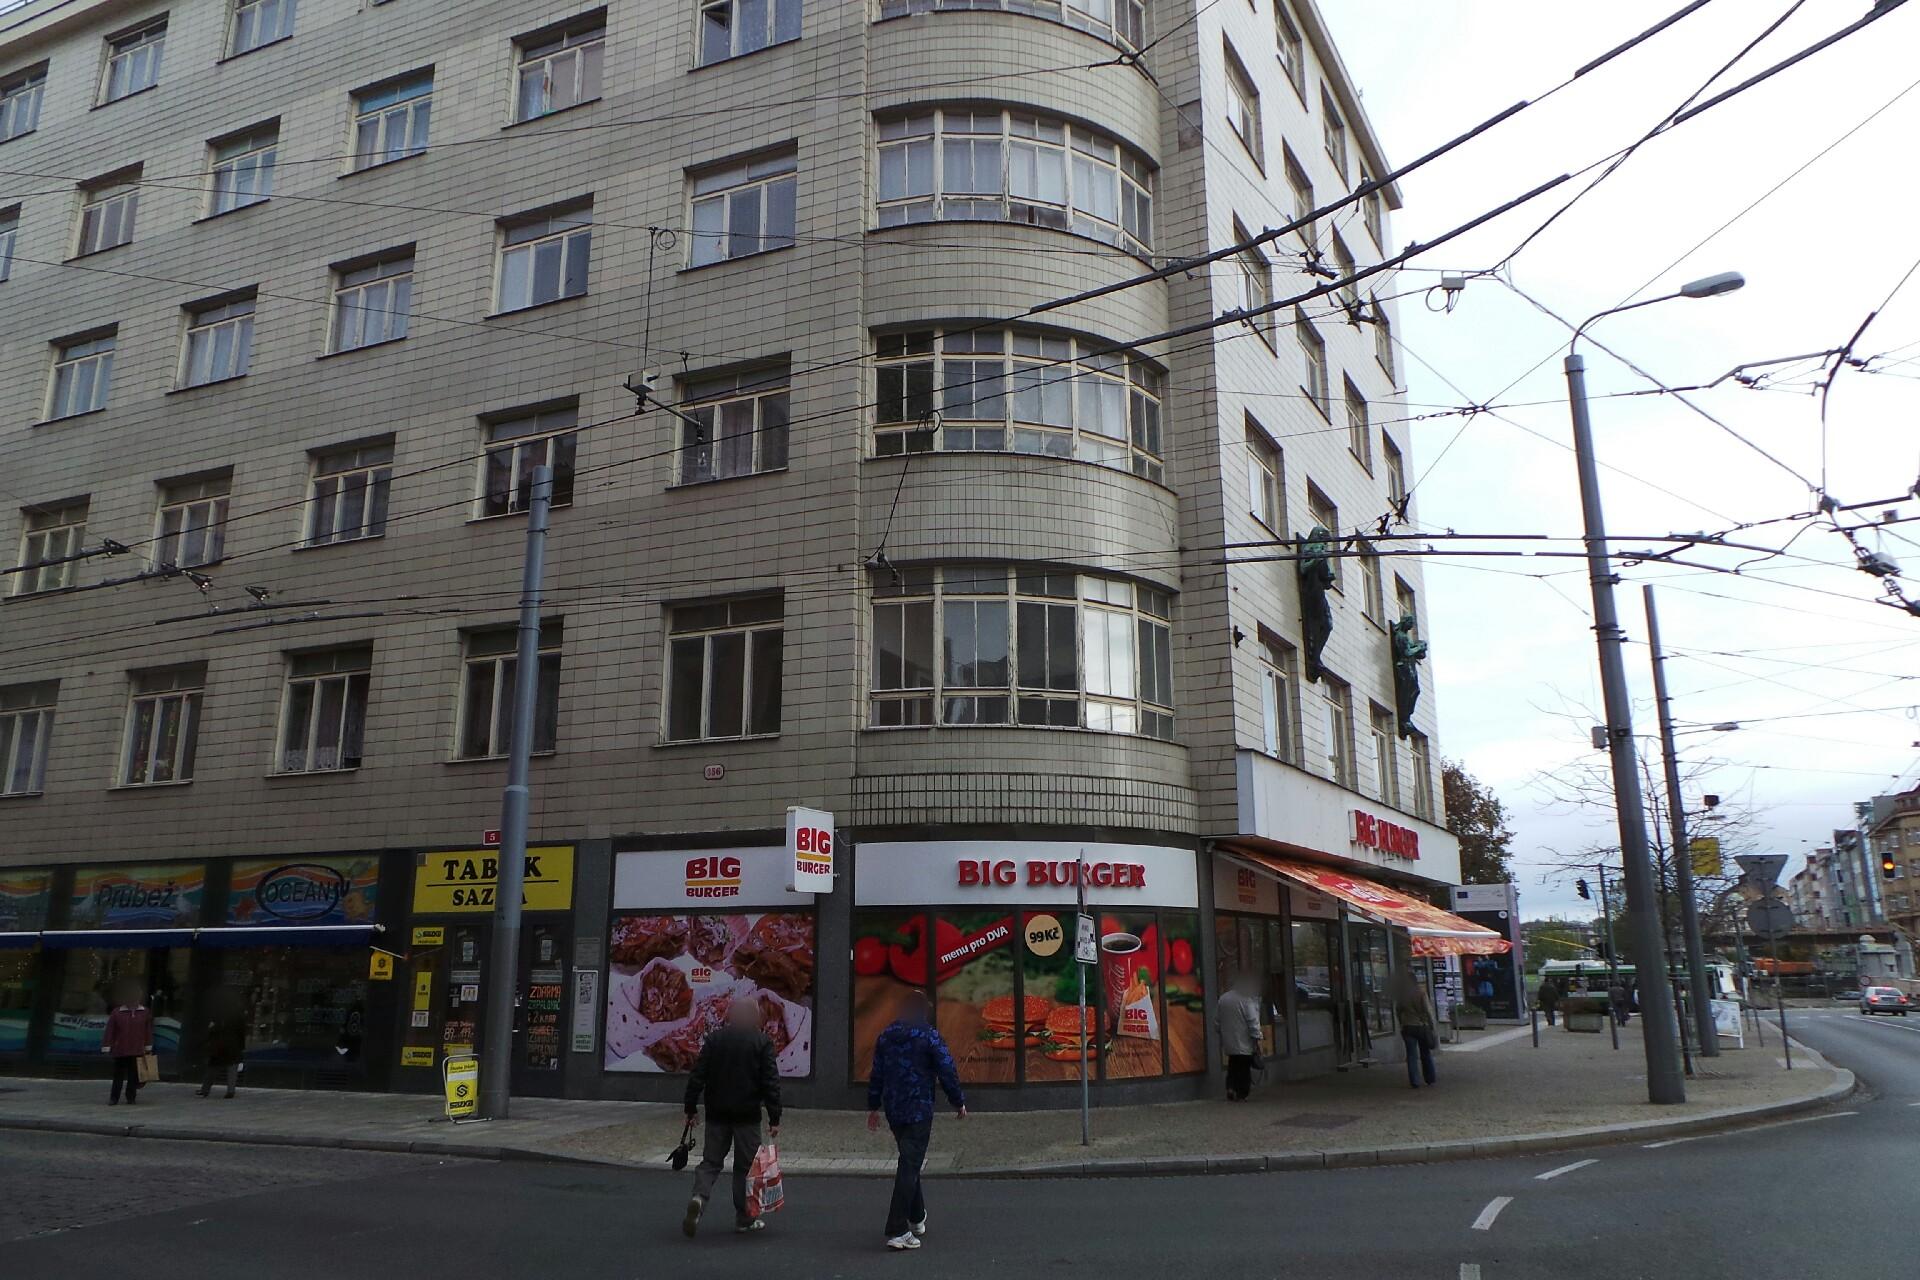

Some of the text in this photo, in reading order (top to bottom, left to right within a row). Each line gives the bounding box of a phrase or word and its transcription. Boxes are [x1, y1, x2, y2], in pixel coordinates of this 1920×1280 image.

[489, 832, 496, 841] 5
[797, 827, 830, 854] BIG
[443, 856, 542, 880] TABK
[686, 857, 741, 878] BIG
[797, 861, 831, 874] BURGER
[958, 860, 1147, 887] BIG BURGER
[452, 888, 528, 906] SAZ
[686, 887, 739, 897] BURGER
[940, 926, 1009, 964] menu pro DVA
[1125, 1009, 1147, 1020] BIG
